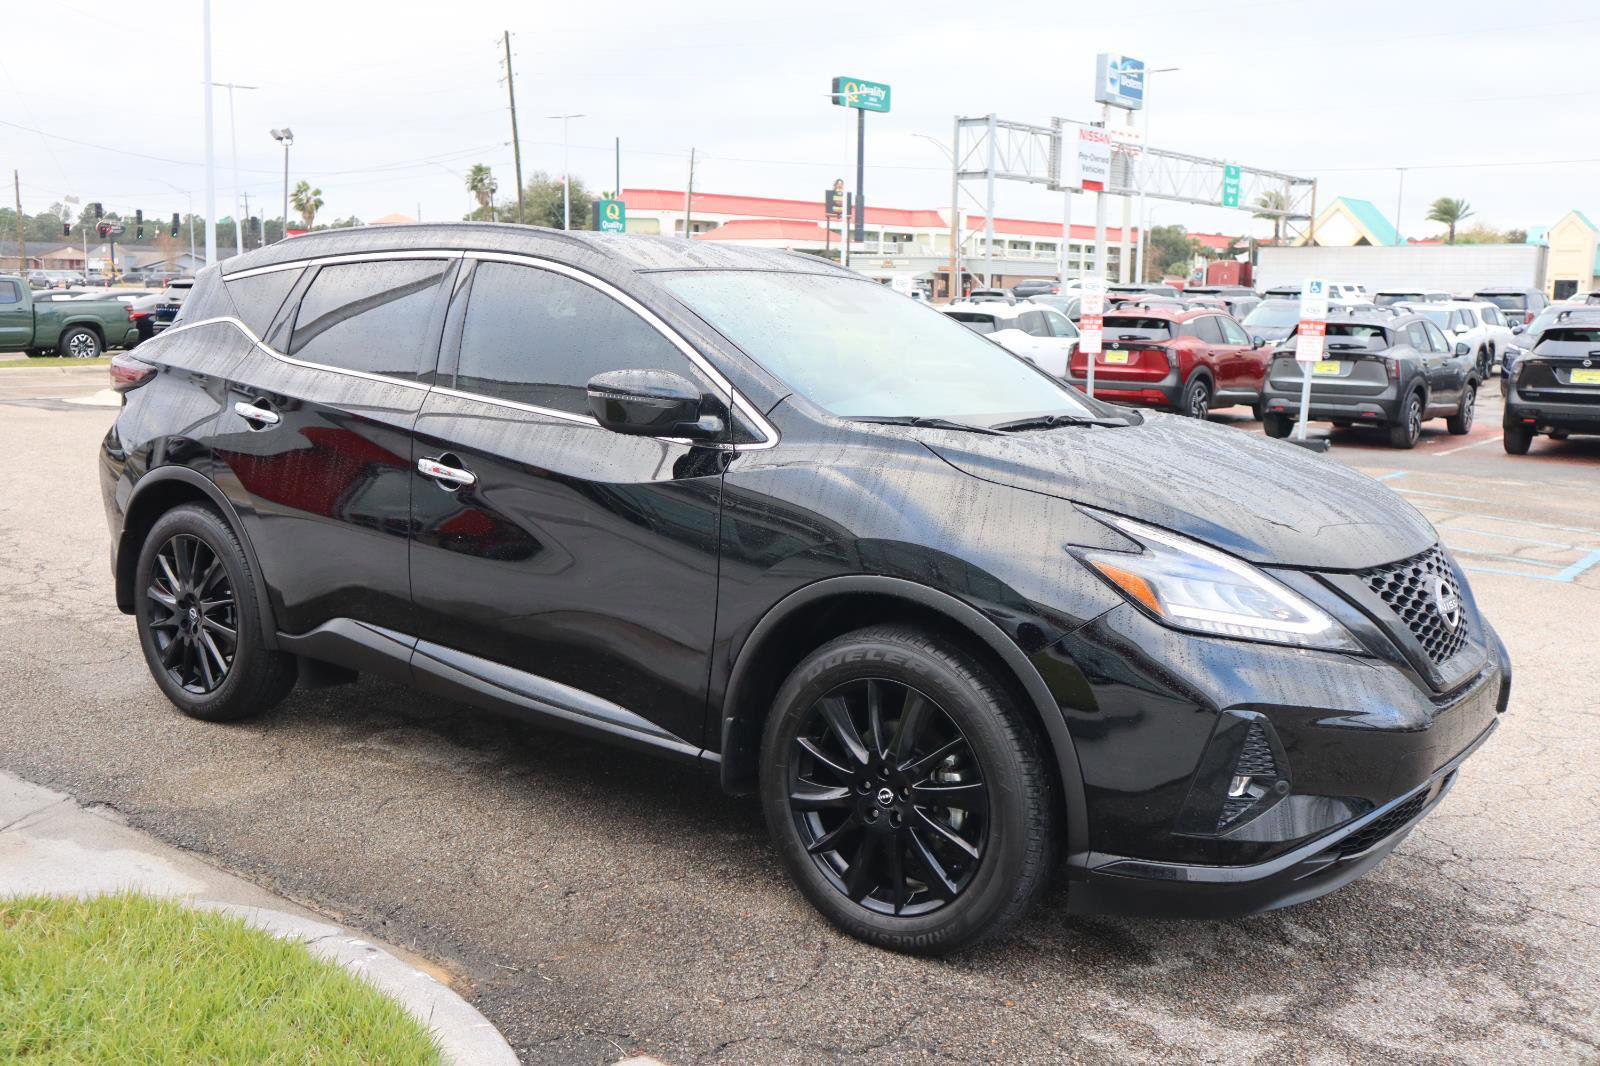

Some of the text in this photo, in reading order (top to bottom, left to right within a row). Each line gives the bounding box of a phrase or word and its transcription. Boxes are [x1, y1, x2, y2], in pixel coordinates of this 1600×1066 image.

[860, 84, 886, 100] Quality
[1079, 129, 1110, 145] NISSAN
[602, 220, 623, 231] Quality
